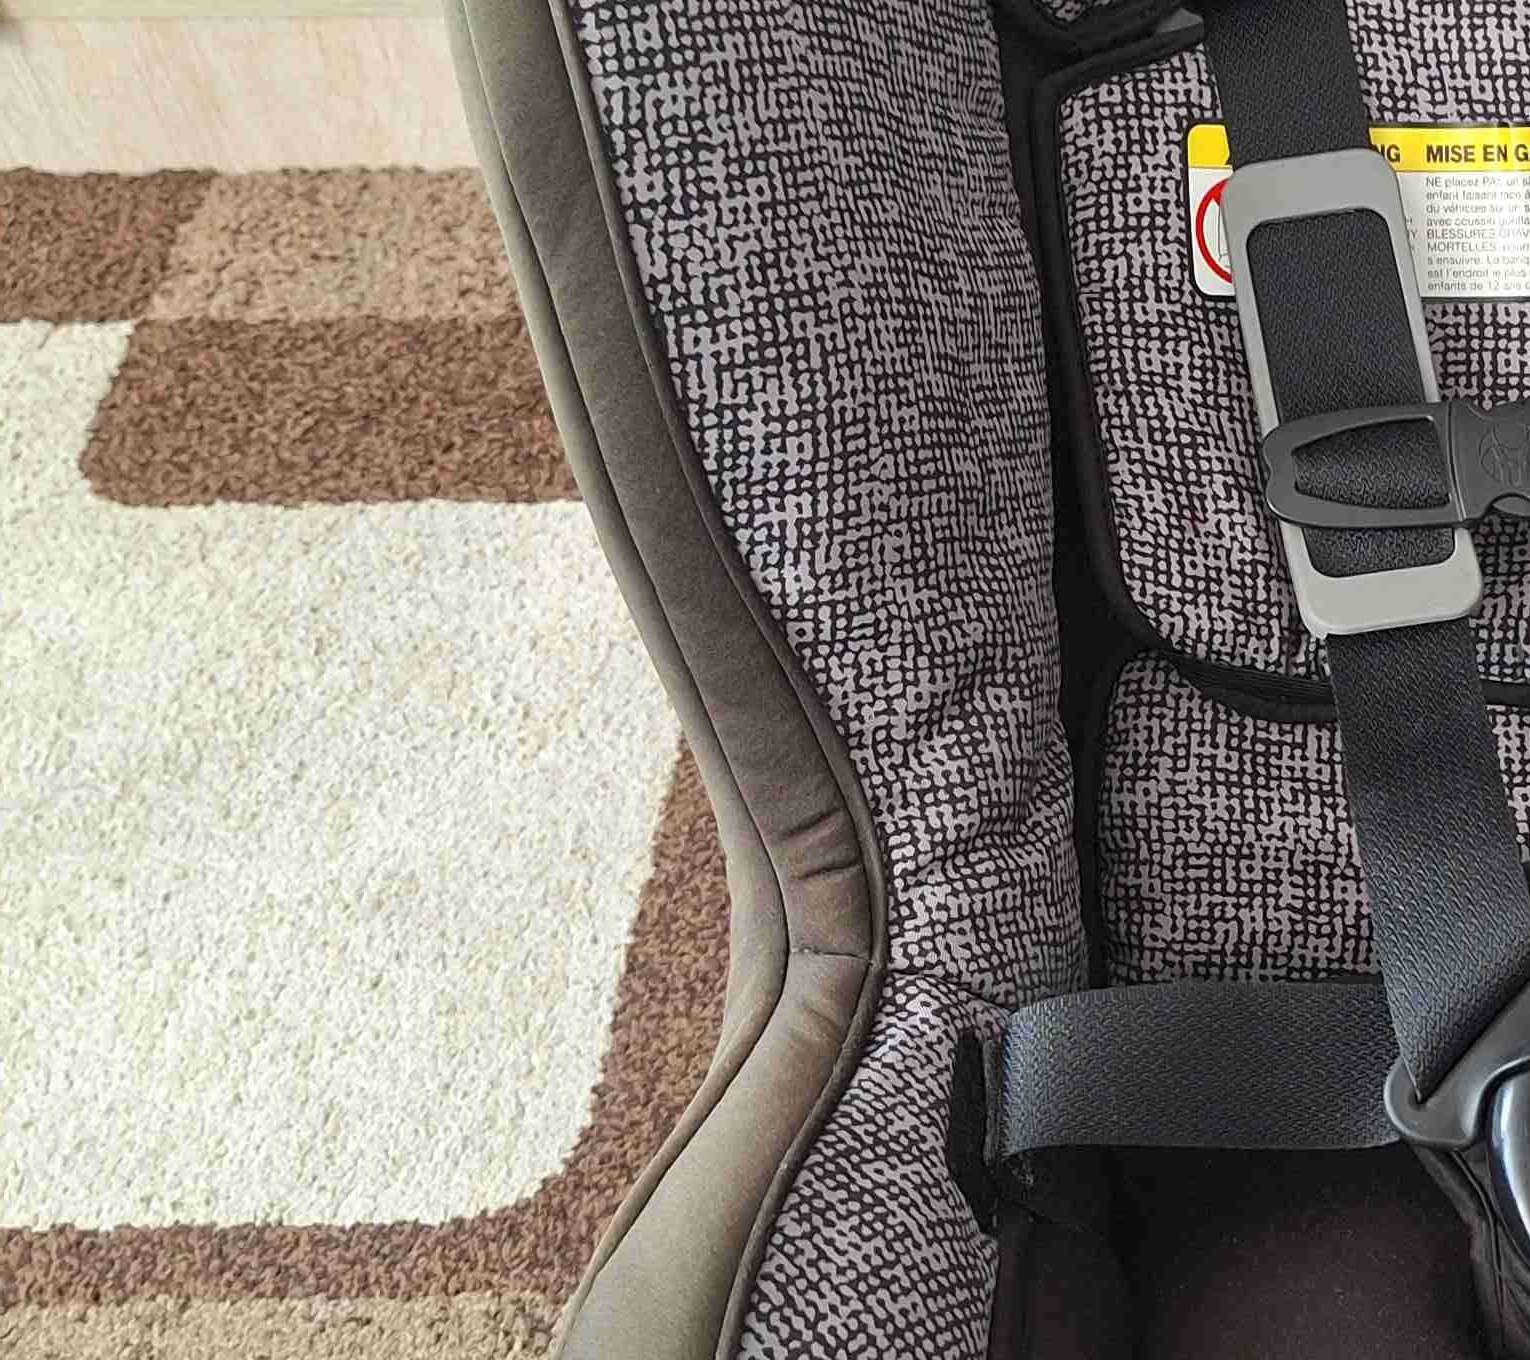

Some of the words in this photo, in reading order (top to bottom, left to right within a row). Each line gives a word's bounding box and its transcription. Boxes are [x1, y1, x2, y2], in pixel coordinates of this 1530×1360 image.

[1426, 144, 1476, 163] MISE
[1482, 144, 1508, 163] EN
[1425, 175, 1442, 188] NE
